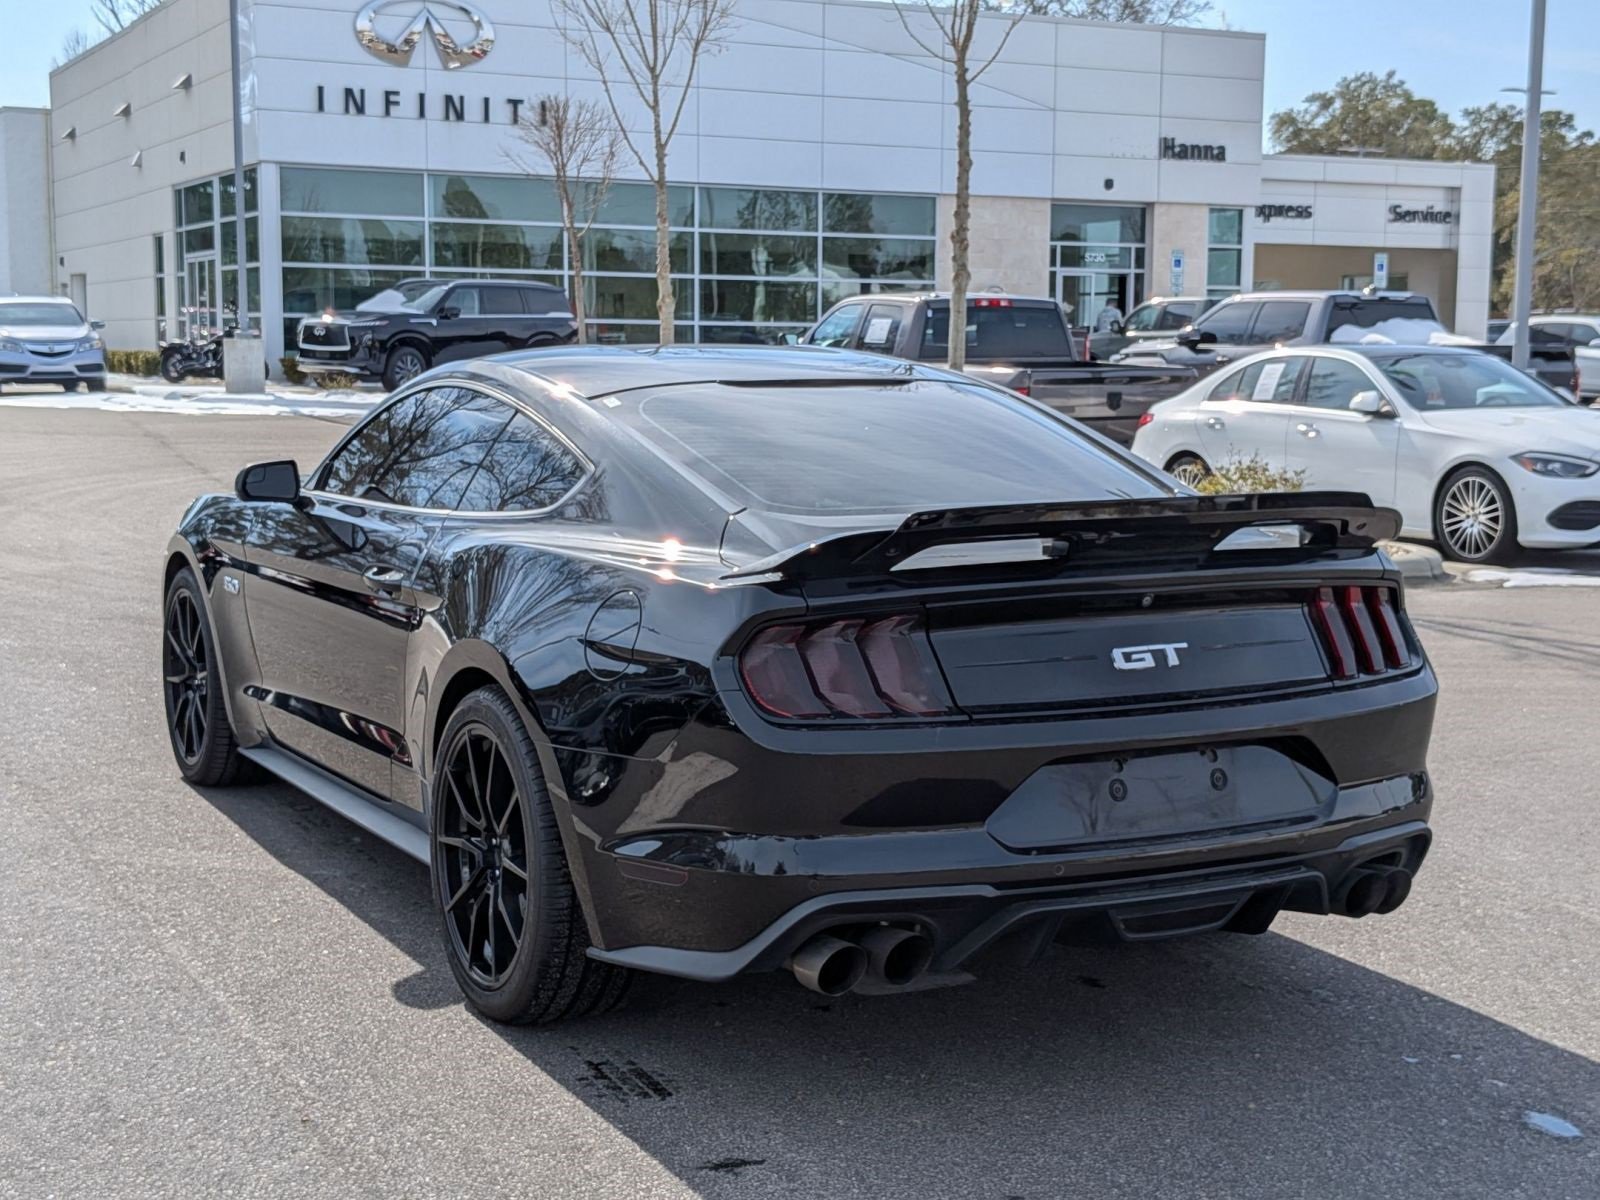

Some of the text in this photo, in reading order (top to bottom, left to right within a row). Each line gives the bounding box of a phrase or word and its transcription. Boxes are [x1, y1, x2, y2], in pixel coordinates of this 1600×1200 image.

[317, 85, 549, 127] INFINITI
[1161, 137, 1226, 162] Hanna
[1255, 204, 1452, 224] xpress Service
[1112, 642, 1188, 670] GT
